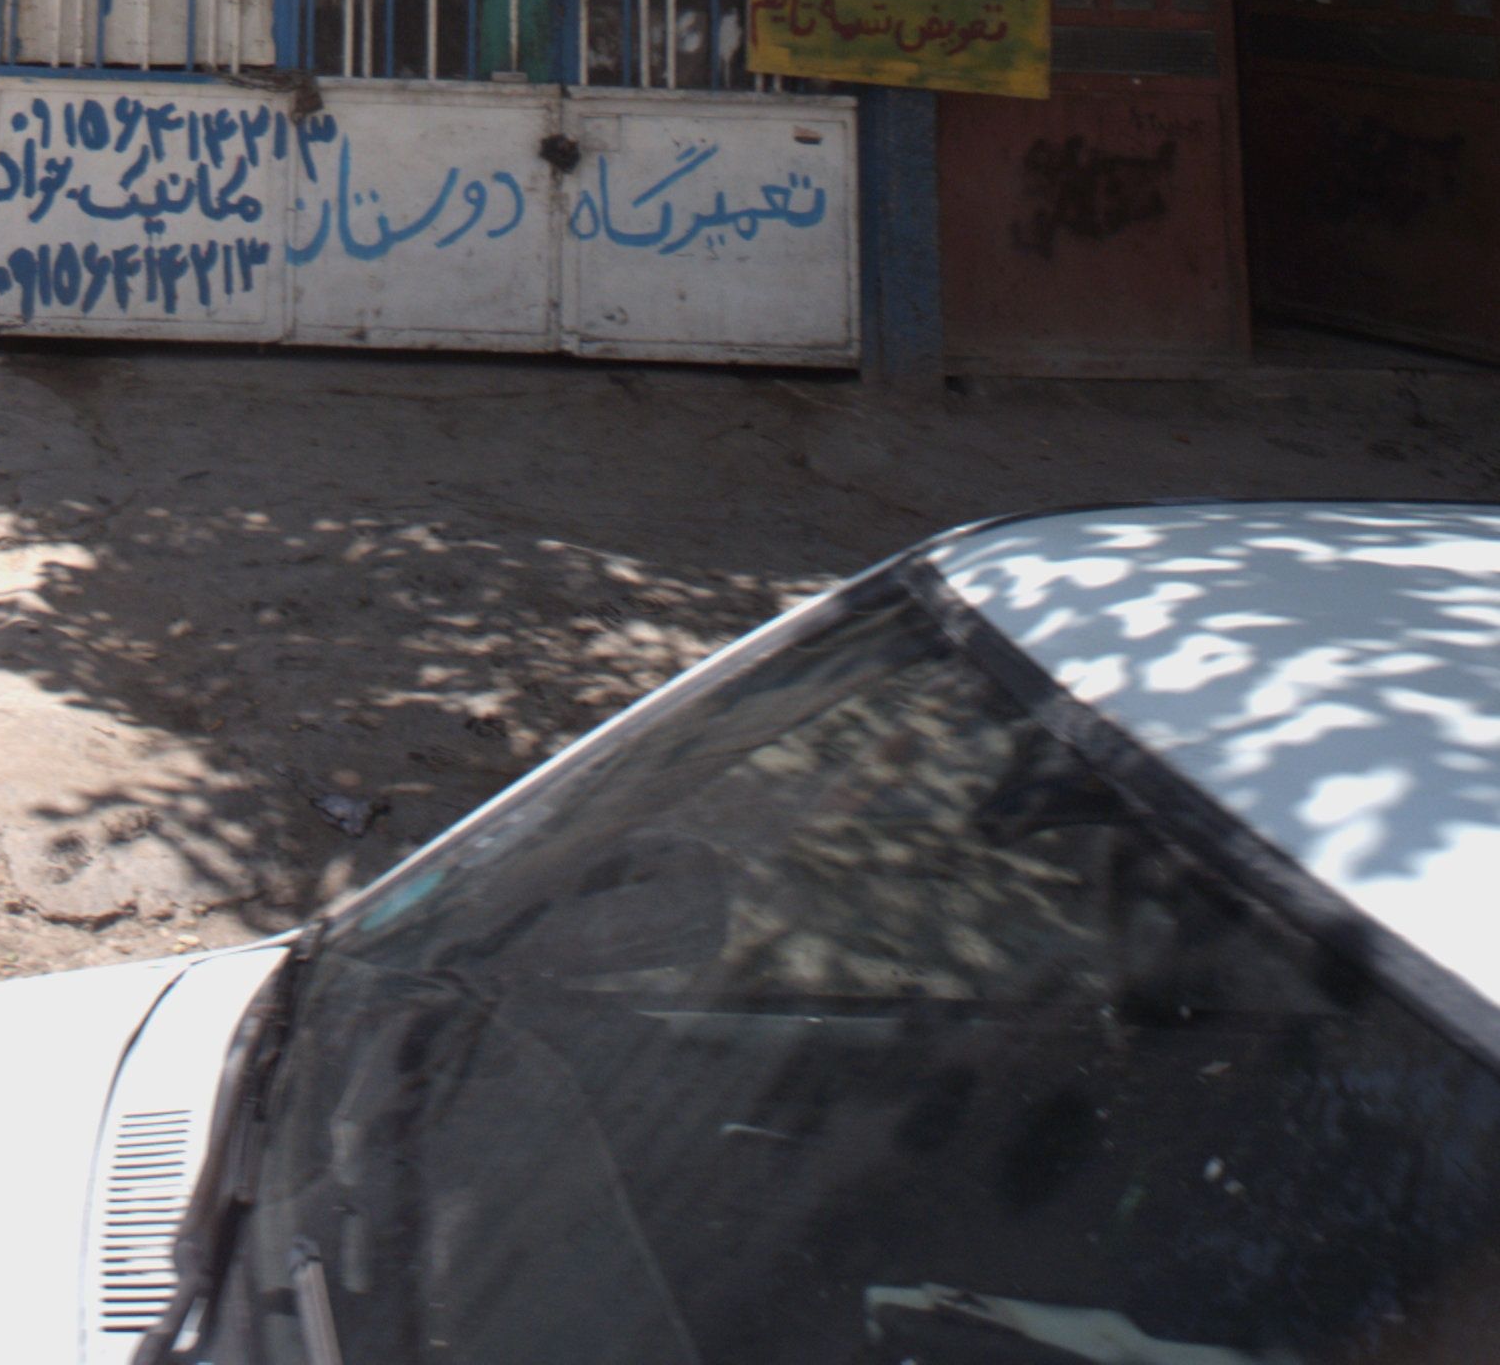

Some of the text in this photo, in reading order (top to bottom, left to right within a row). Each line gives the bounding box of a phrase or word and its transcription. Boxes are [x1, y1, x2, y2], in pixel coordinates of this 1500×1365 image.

[895, 3, 1009, 56] تعویض
[10, 95, 338, 184] ۰۹۱۵۶۴۱۴۲۱۳
[77, 143, 263, 235] مکانیک
[283, 133, 827, 268] تعمیرگاه دوستان
